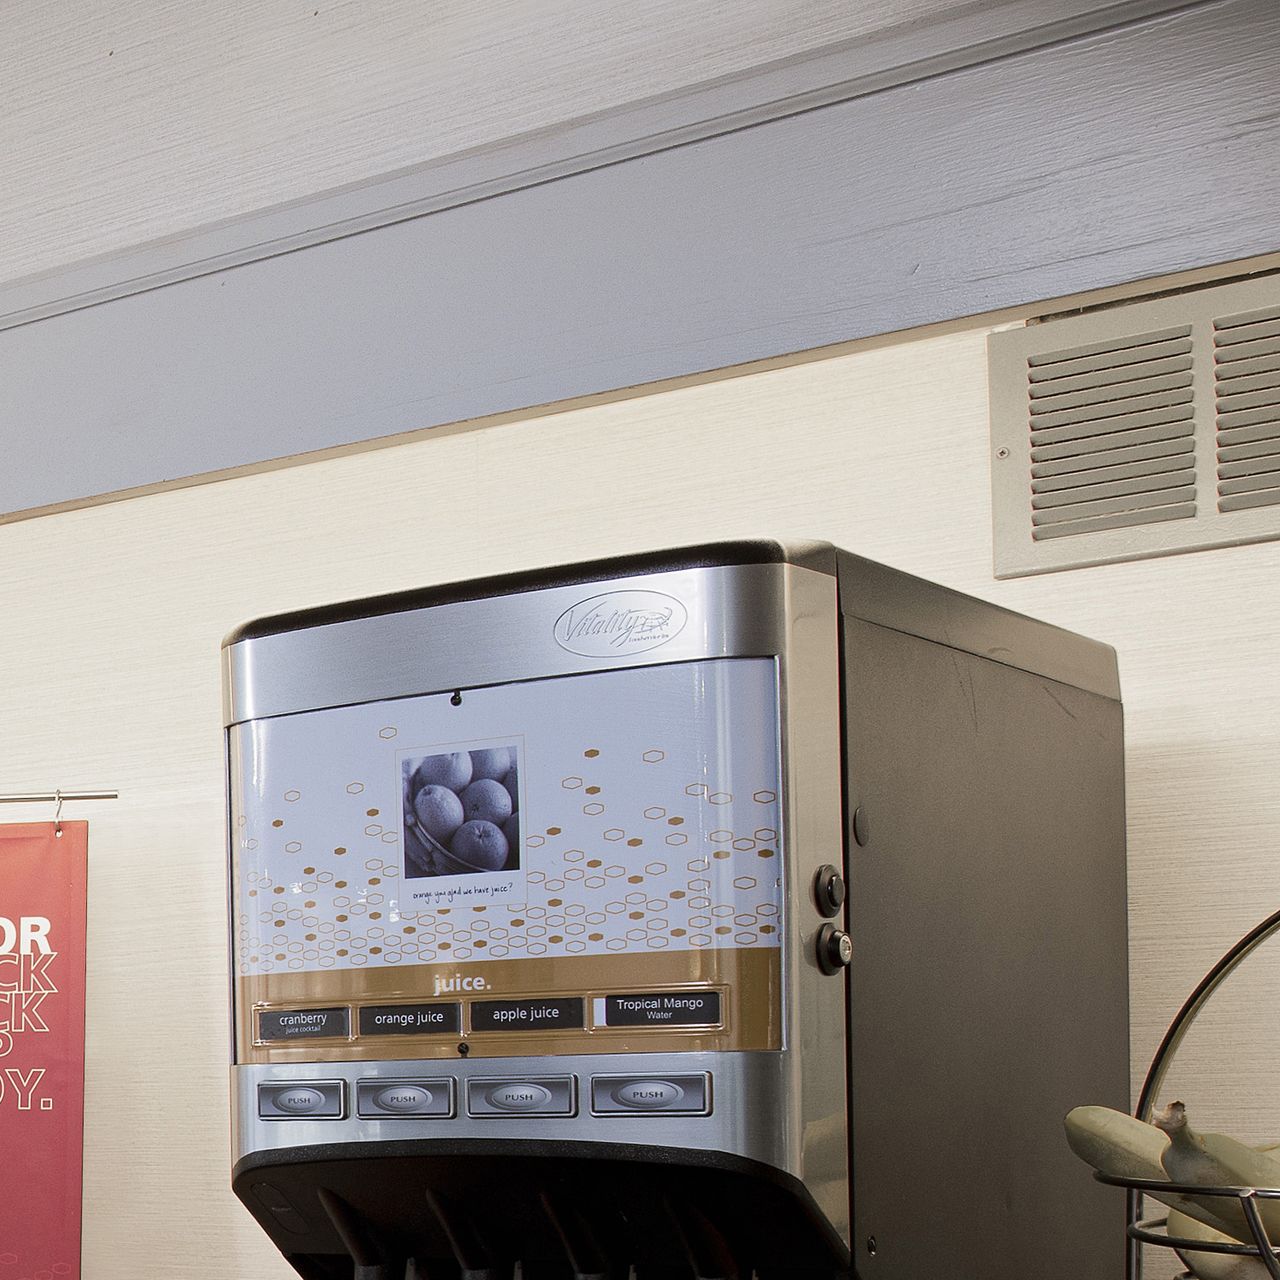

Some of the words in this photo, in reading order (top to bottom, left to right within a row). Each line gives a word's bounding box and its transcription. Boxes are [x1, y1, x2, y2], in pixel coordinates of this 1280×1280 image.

[563, 601, 639, 648] Vitality
[447, 886, 462, 903] glad
[474, 885, 489, 895] have
[491, 882, 513, 896] juice?
[433, 973, 492, 996] juice.
[616, 998, 661, 1012] Tropical
[664, 997, 704, 1011] Mango
[279, 1012, 327, 1026] cranberry
[375, 1013, 414, 1027] orange
[416, 1011, 444, 1026] juice
[493, 1007, 527, 1021] apple
[530, 1006, 560, 1021] juice
[647, 1010, 673, 1019] Water
[285, 1026, 299, 1034] juice
[300, 1025, 321, 1033] cocktail
[390, 1095, 416, 1103] PUSH
[505, 1093, 533, 1101] PUSH
[632, 1091, 664, 1099] PUSH
